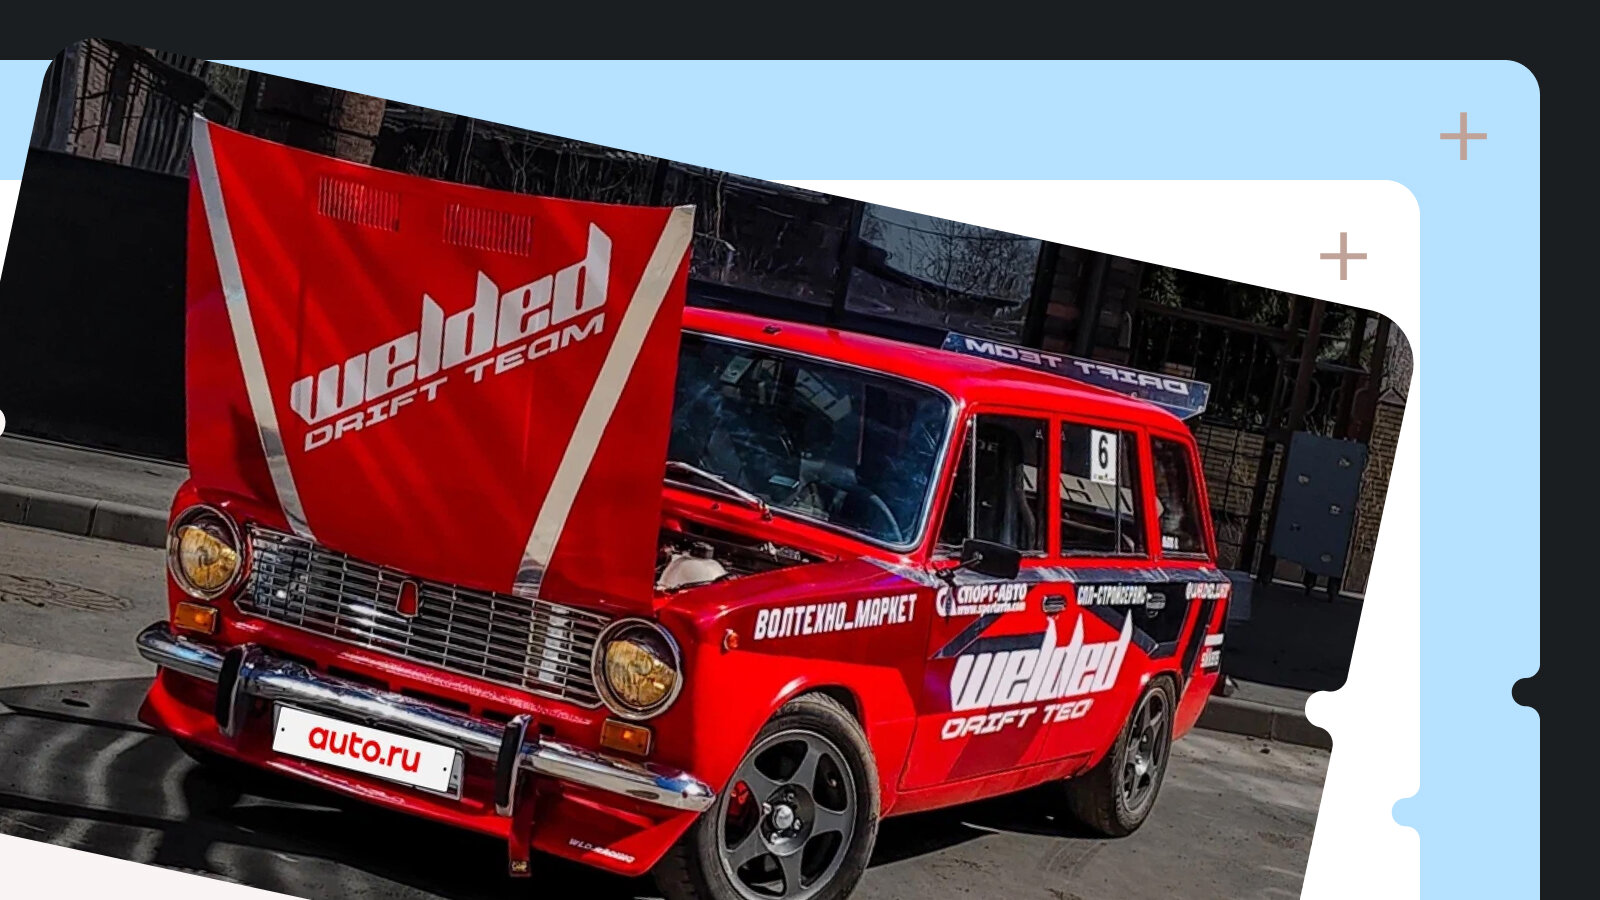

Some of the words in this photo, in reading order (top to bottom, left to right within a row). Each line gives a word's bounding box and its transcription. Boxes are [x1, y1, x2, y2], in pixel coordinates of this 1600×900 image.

[289, 221, 612, 426] welded
[304, 376, 448, 452] DRIFT
[464, 312, 605, 383] TEAM
[1098, 434, 1109, 470] 6
[753, 593, 917, 640] ВОЛТЕХНО_МАРКЕТ
[950, 608, 1133, 712] welded
[941, 706, 1037, 740] DRIFT
